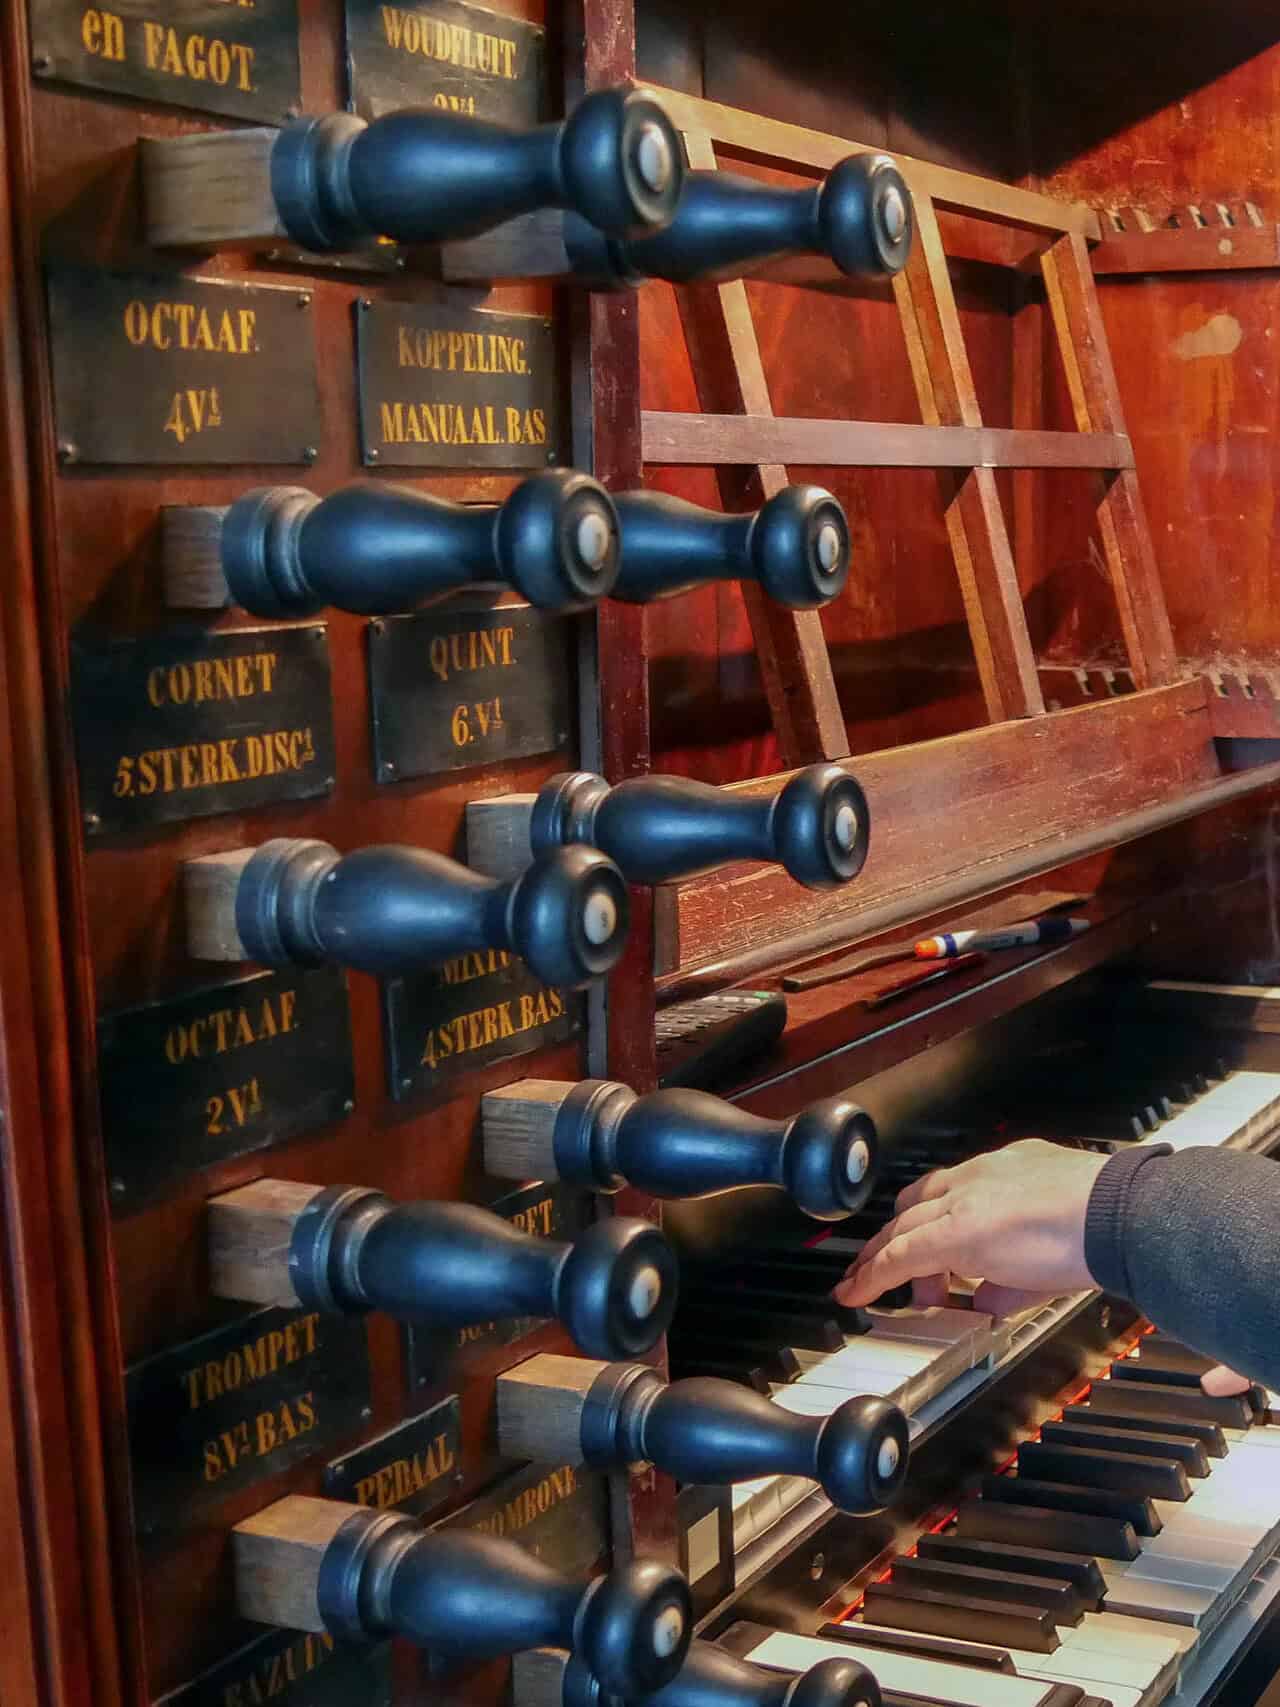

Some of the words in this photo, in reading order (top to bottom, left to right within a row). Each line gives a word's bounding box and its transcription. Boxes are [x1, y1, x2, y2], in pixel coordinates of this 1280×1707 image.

[81, 9, 126, 61] en
[147, 653, 278, 708] CORNET
[353, 1432, 455, 1511] PEDAAL
